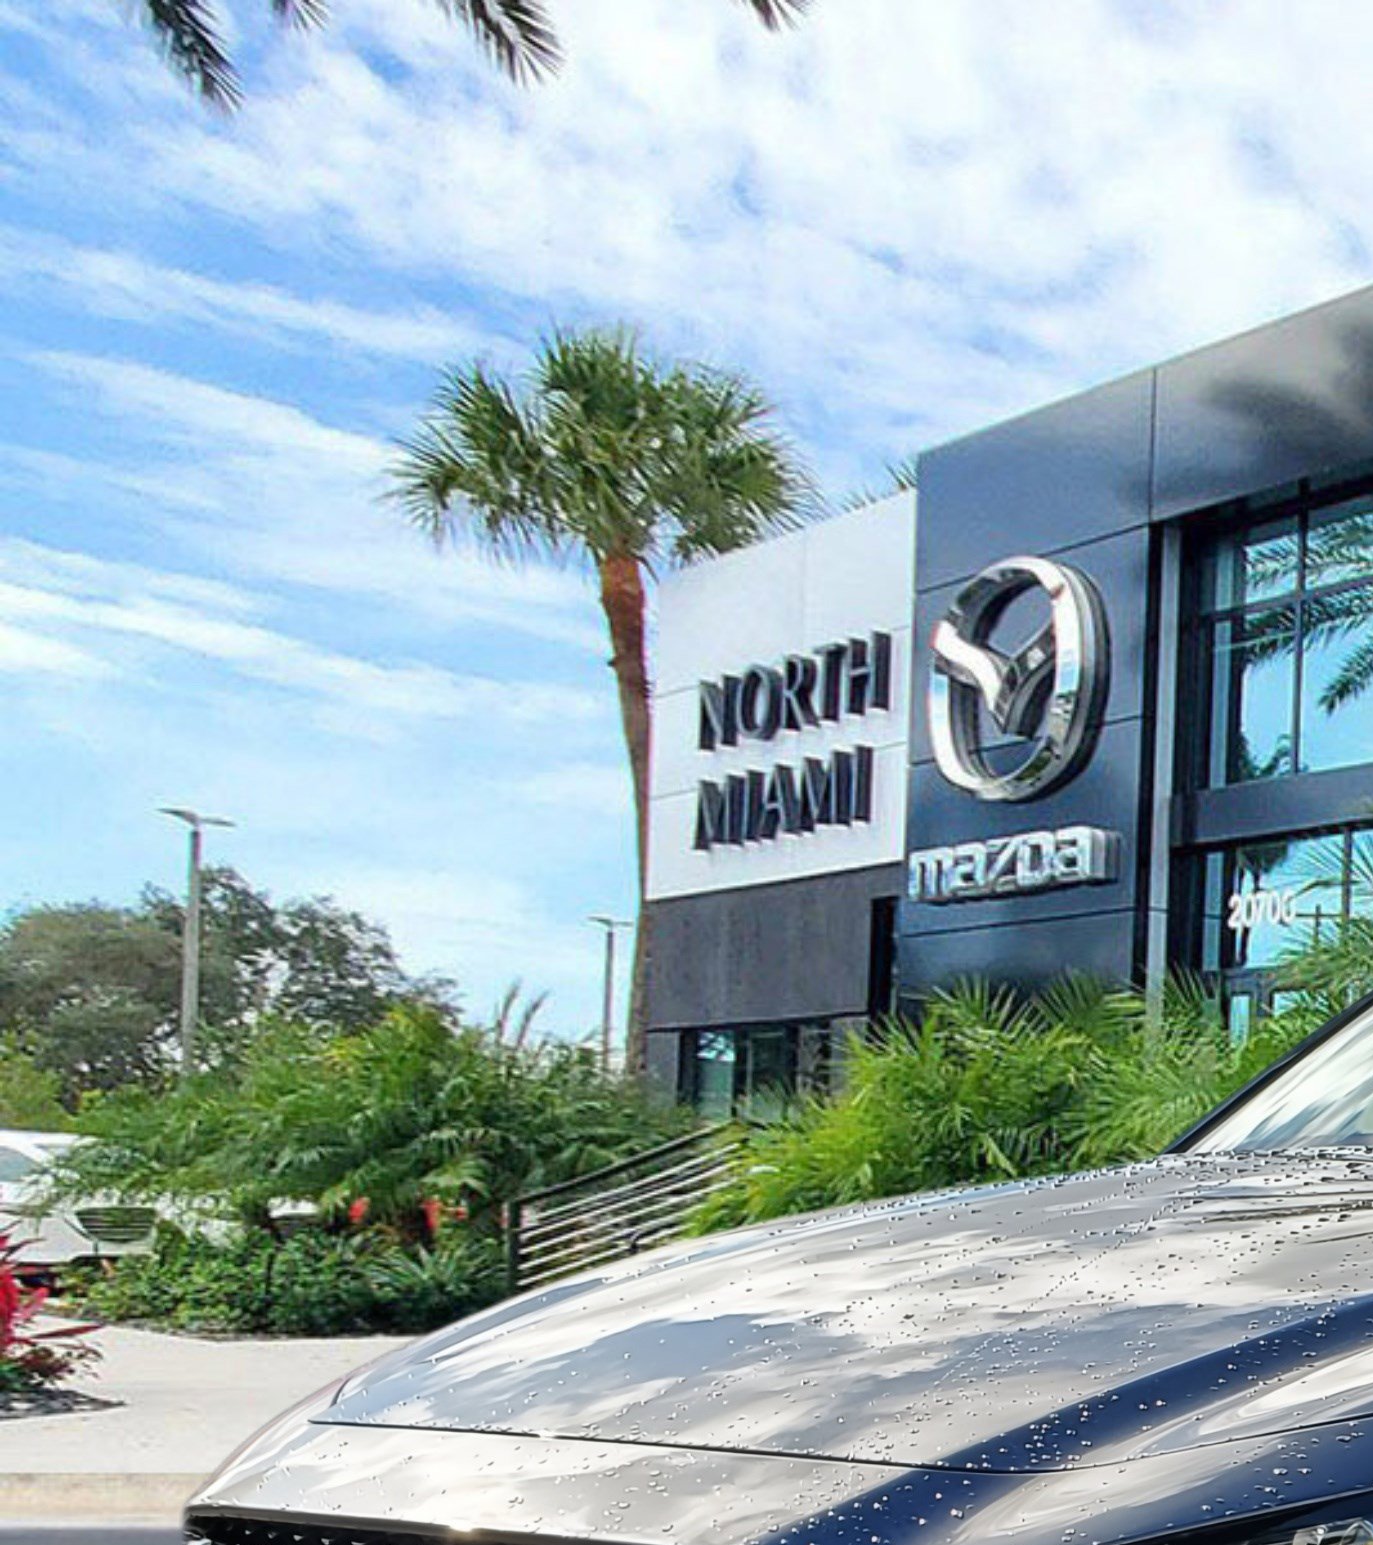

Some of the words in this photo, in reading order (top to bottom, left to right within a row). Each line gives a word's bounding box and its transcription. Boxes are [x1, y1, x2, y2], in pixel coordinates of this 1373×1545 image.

[698, 630, 892, 752] NORTH
[693, 745, 874, 849] MIAMI
[908, 827, 1118, 902] mazda
